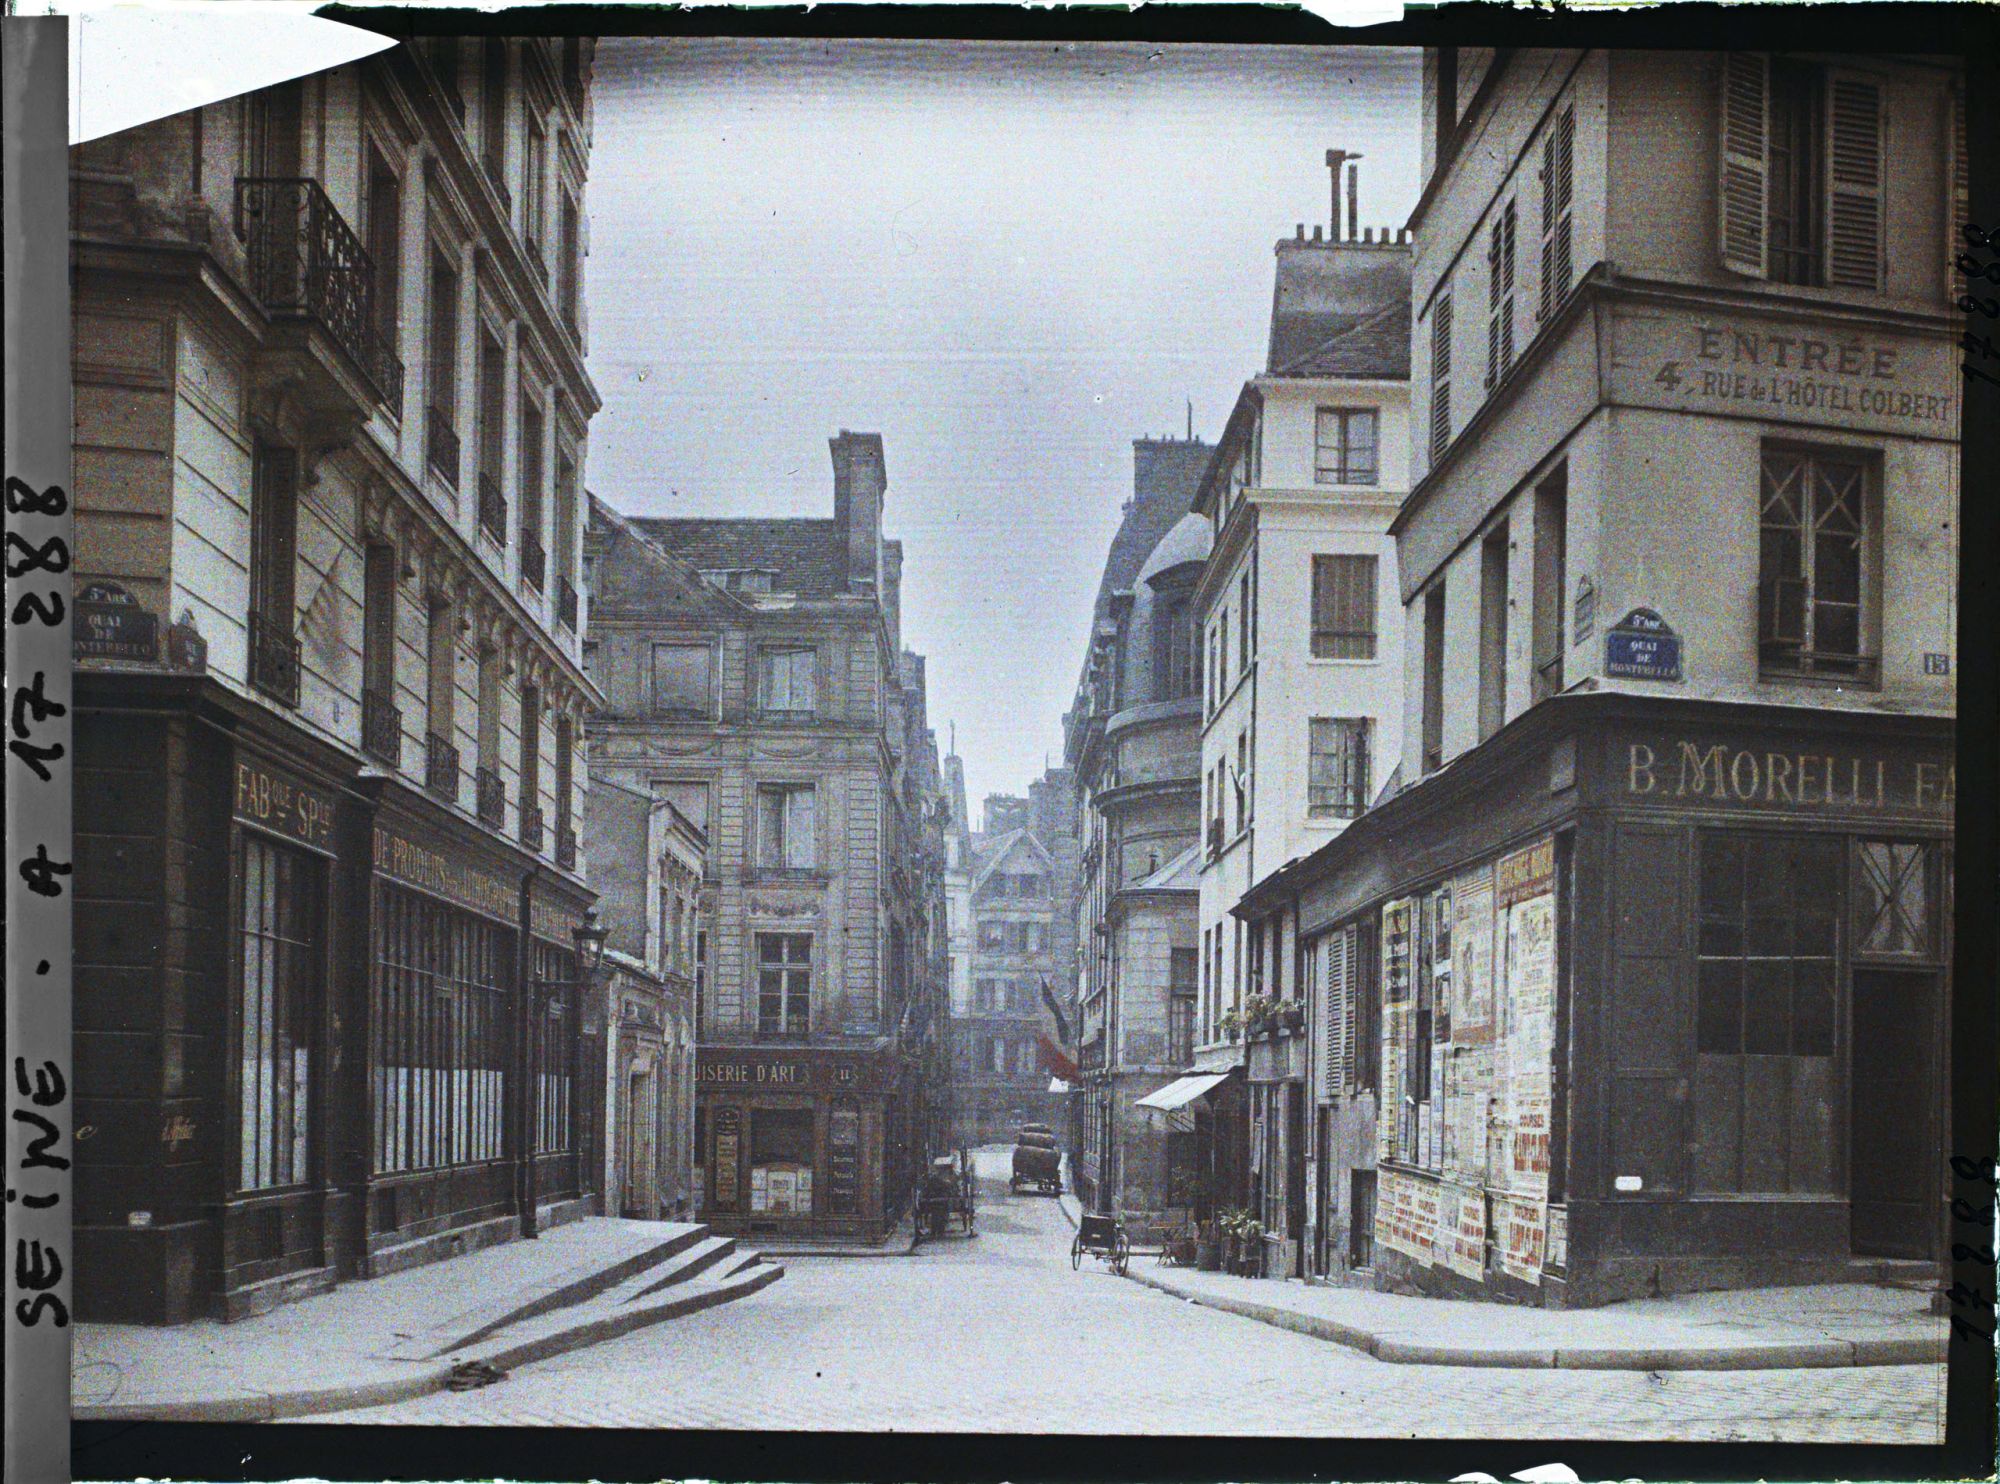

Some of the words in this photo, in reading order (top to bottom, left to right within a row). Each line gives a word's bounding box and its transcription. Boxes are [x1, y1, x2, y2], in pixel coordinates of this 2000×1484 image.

[1699, 326, 1897, 379] ENTRÉE
[1701, 369, 1746, 400] RUE
[1859, 387, 1952, 421] COLBERT
[88, 614, 120, 627] QUAI
[94, 627, 113, 640] DE
[1630, 641, 1657, 652] QUAI
[1636, 653, 1651, 664] DE
[1675, 740, 1884, 808] MORELLI
[373, 827, 389, 869] DE
[393, 835, 447, 892] PRODUITS
[756, 1064, 796, 1083] D'ART
